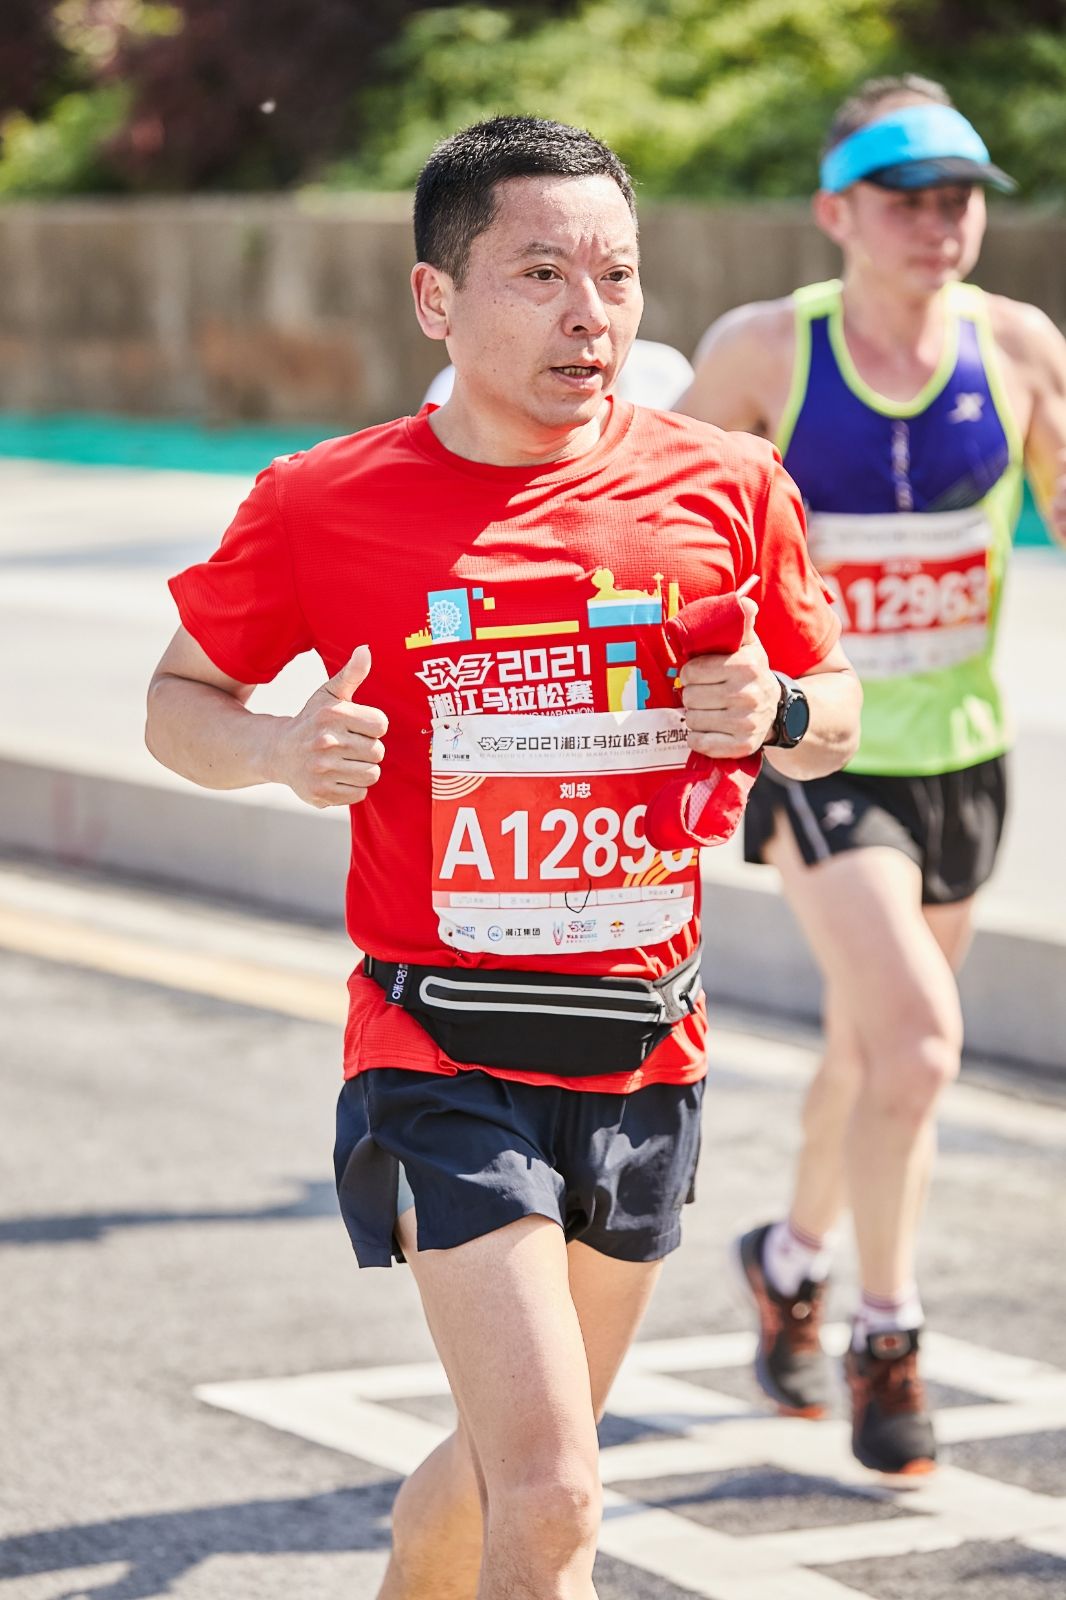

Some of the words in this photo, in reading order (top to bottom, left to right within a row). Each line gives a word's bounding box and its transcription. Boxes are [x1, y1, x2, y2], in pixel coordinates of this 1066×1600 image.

[496, 644, 591, 683] 2021
[427, 680, 594, 720] 湘江马拉松赛
[559, 782, 592, 800] 刘忠
[391, 963, 408, 1000] 咪咕
